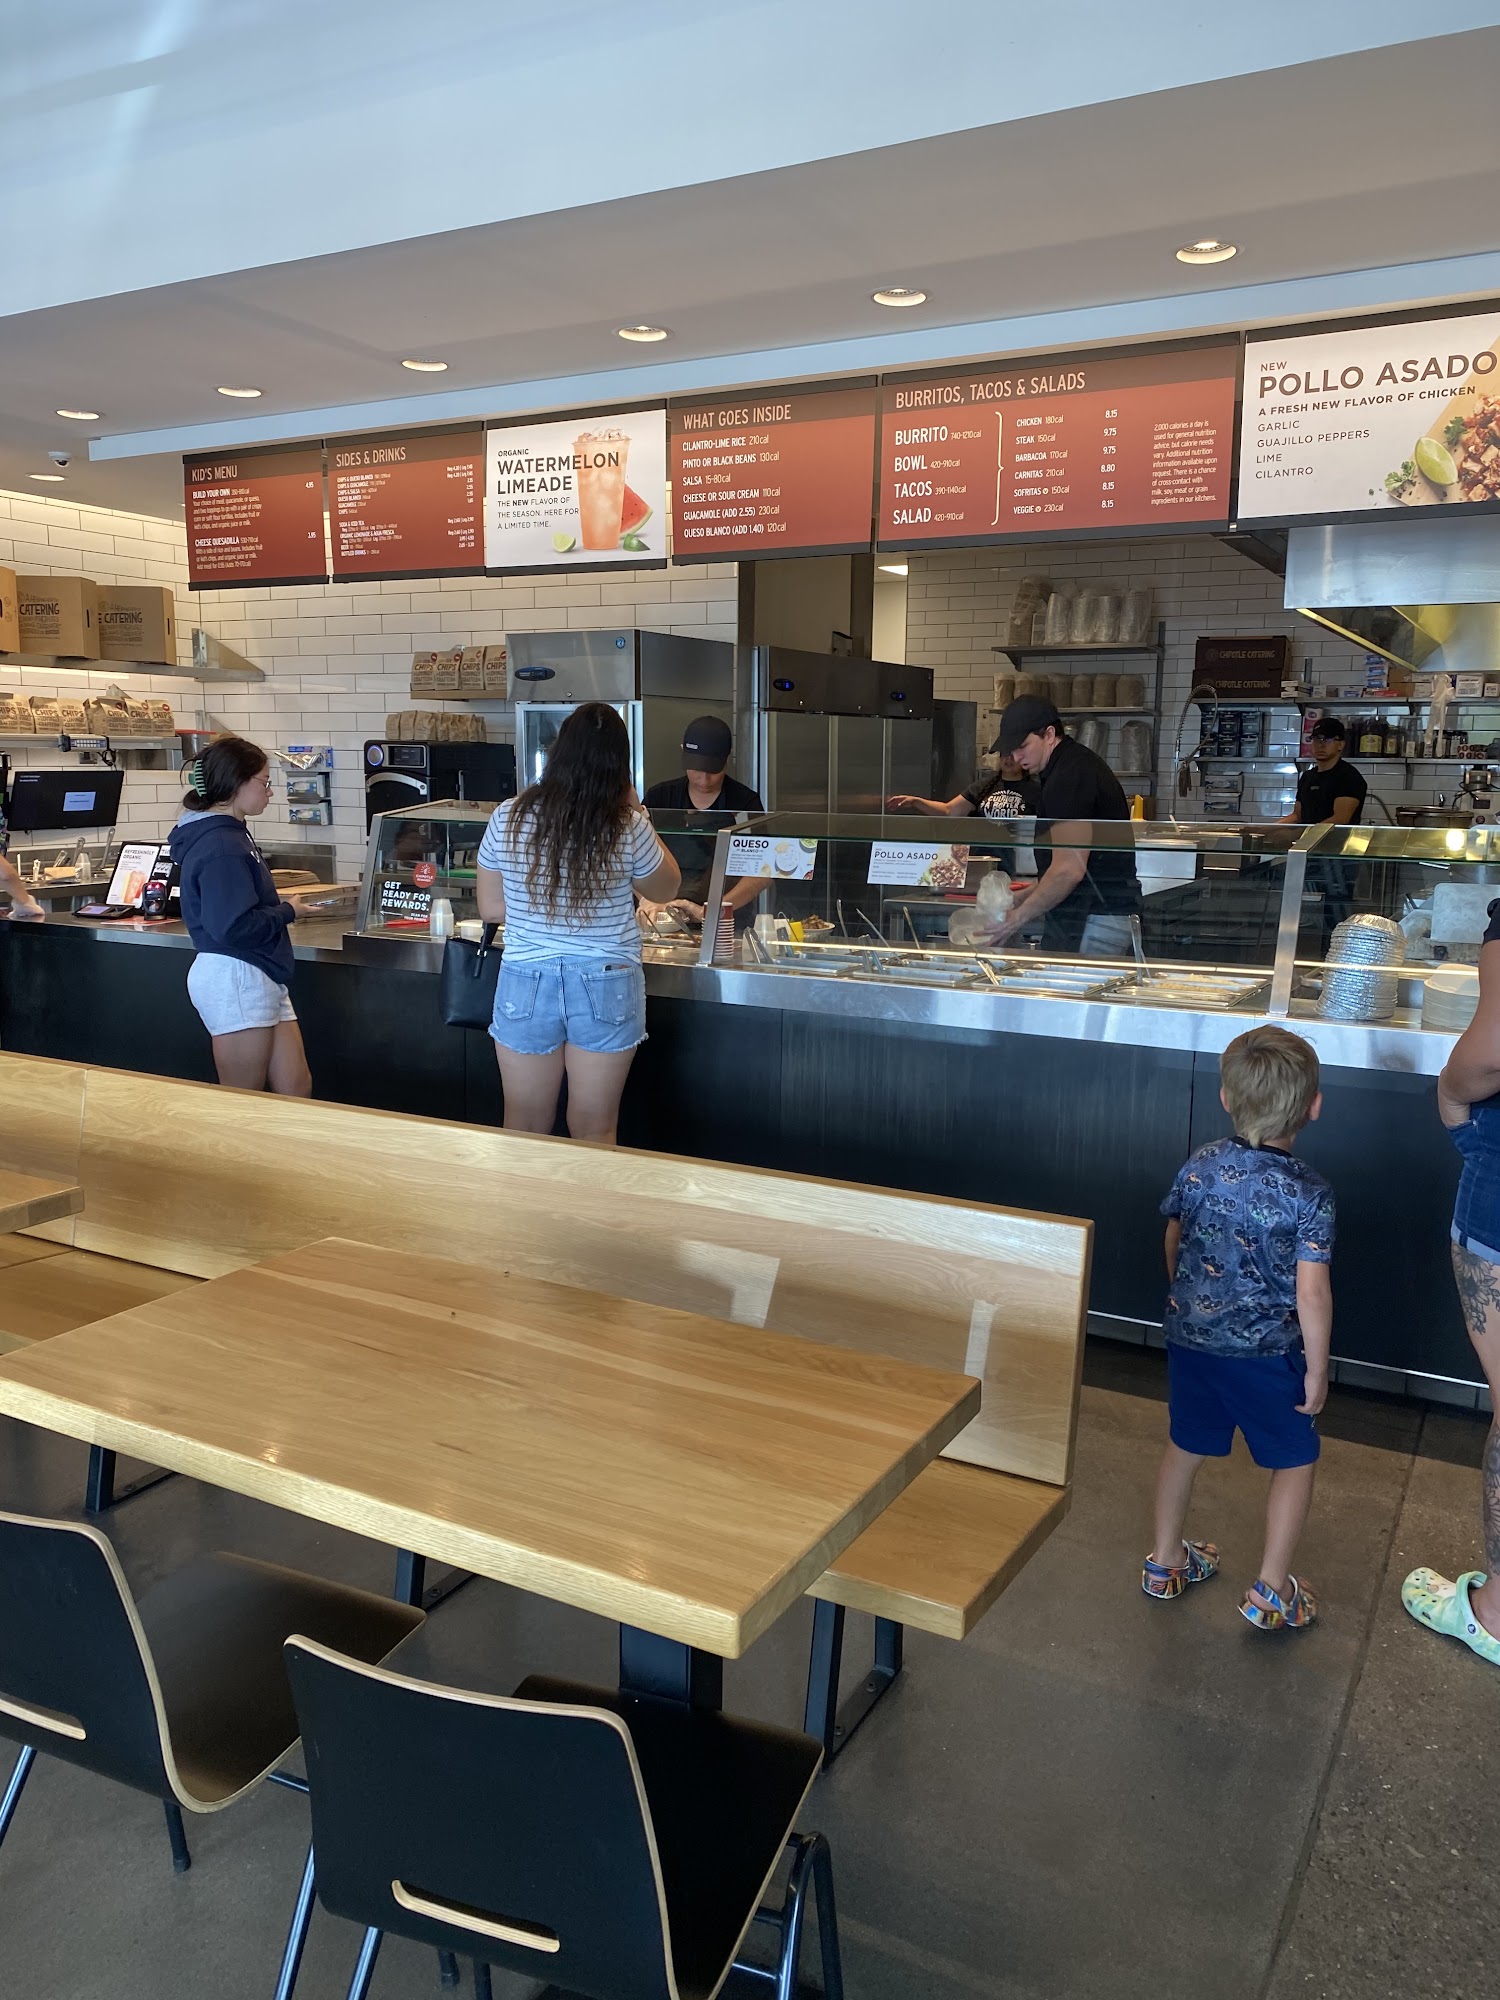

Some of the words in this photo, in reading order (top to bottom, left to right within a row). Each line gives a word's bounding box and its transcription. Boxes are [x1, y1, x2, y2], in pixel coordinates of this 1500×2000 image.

[1260, 361, 1287, 372] NEW
[1259, 366, 1364, 398] POLLO
[1375, 351, 1498, 386] ASADO
[896, 386, 964, 408] BURRITOS,
[970, 380, 1012, 400] TACOS
[1017, 379, 1025, 395] &
[1031, 372, 1086, 393] SALADS
[1259, 408, 1266, 416] A
[1271, 404, 1308, 414] FRESH
[1312, 400, 1340, 411] NEW
[1344, 395, 1393, 408] FLAVOR
[1398, 392, 1414, 402] OF
[1419, 386, 1476, 400] CHICKEN
[684, 412, 714, 429] WHAT
[719, 409, 748, 426] GOES
[753, 404, 791, 423] INSIDE
[1105, 410, 1117, 418] 8.15
[1017, 417, 1042, 427] CHICKEN
[1045, 415, 1064, 424] 180cal
[1258, 420, 1300, 432] GARLIC
[895, 426, 948, 445] BURRITO
[1104, 428, 1116, 436] 9.75
[1175, 431, 1194, 439] general
[683, 438, 730, 451] CILANTRO-LIME
[732, 437, 746, 446] RICE
[749, 434, 769, 445] 210cal
[1016, 436, 1034, 444] STEAK
[1038, 433, 1056, 442] 150cal
[1257, 435, 1313, 448] GUAJILLO
[1318, 429, 1370, 443] PEPPERS
[1016, 452, 1047, 462] BARBACOA
[1050, 450, 1068, 459] 170cal
[1103, 446, 1116, 454] 9.75
[336, 452, 361, 467] SIDES
[364, 451, 370, 464] &
[373, 447, 406, 463] DRINKS
[683, 459, 700, 468] PINTO
[703, 458, 711, 466] OR
[713, 456, 733, 466] BLACK
[735, 454, 756, 464] BEANS
[760, 451, 780, 462] 130cal
[1257, 454, 1282, 464] LIME
[498, 452, 619, 475] WATERMELON
[894, 455, 927, 472] BOWL
[1101, 464, 1115, 472] 8.80
[1153, 460, 1180, 468] information
[192, 468, 212, 481] KID'S
[215, 465, 237, 479] MENU
[1015, 470, 1043, 479] CARNITAS
[1046, 468, 1065, 477] 210cal
[1256, 466, 1313, 479] CILANTRO
[498, 476, 572, 494] LIMEADE
[683, 476, 702, 486] SALSA
[705, 474, 731, 484] 15-80cal
[1102, 482, 1114, 490] 8.15
[683, 493, 706, 503] CHEESE
[708, 492, 716, 501] OR
[718, 491, 735, 501] SOUR
[737, 489, 759, 499] CREAM
[763, 487, 780, 497] 110cal
[894, 481, 932, 498] TACOS
[1014, 488, 1041, 497] SOFRITAS
[1052, 485, 1070, 494] 150cal
[1195, 485, 1208, 494] grain
[1102, 500, 1114, 508] 8.15
[1151, 497, 1178, 506] ingredients
[684, 509, 720, 520] GUACAMOLE
[722, 508, 737, 519] (ADD
[739, 507, 756, 517] 2.55)
[759, 505, 780, 515] 230cal
[1014, 506, 1034, 514] VEGGIE
[1044, 504, 1064, 512] 230cal
[893, 508, 931, 524] SALAD
[684, 528, 704, 538] QUESO
[706, 526, 730, 536] BLANCO
[732, 525, 747, 535] (ADD
[749, 524, 764, 534] 1.40)
[767, 522, 786, 532] 120cal
[195, 538, 211, 547] CHEESE
[213, 537, 239, 545] QUESADILLA
[20, 603, 59, 615] CATERING
[104, 612, 142, 623] CATERING
[733, 840, 769, 848] QUESO
[384, 881, 401, 889] GET
[383, 890, 411, 899] READY
[413, 893, 431, 902] FOR
[382, 898, 429, 911] REWARDS.
